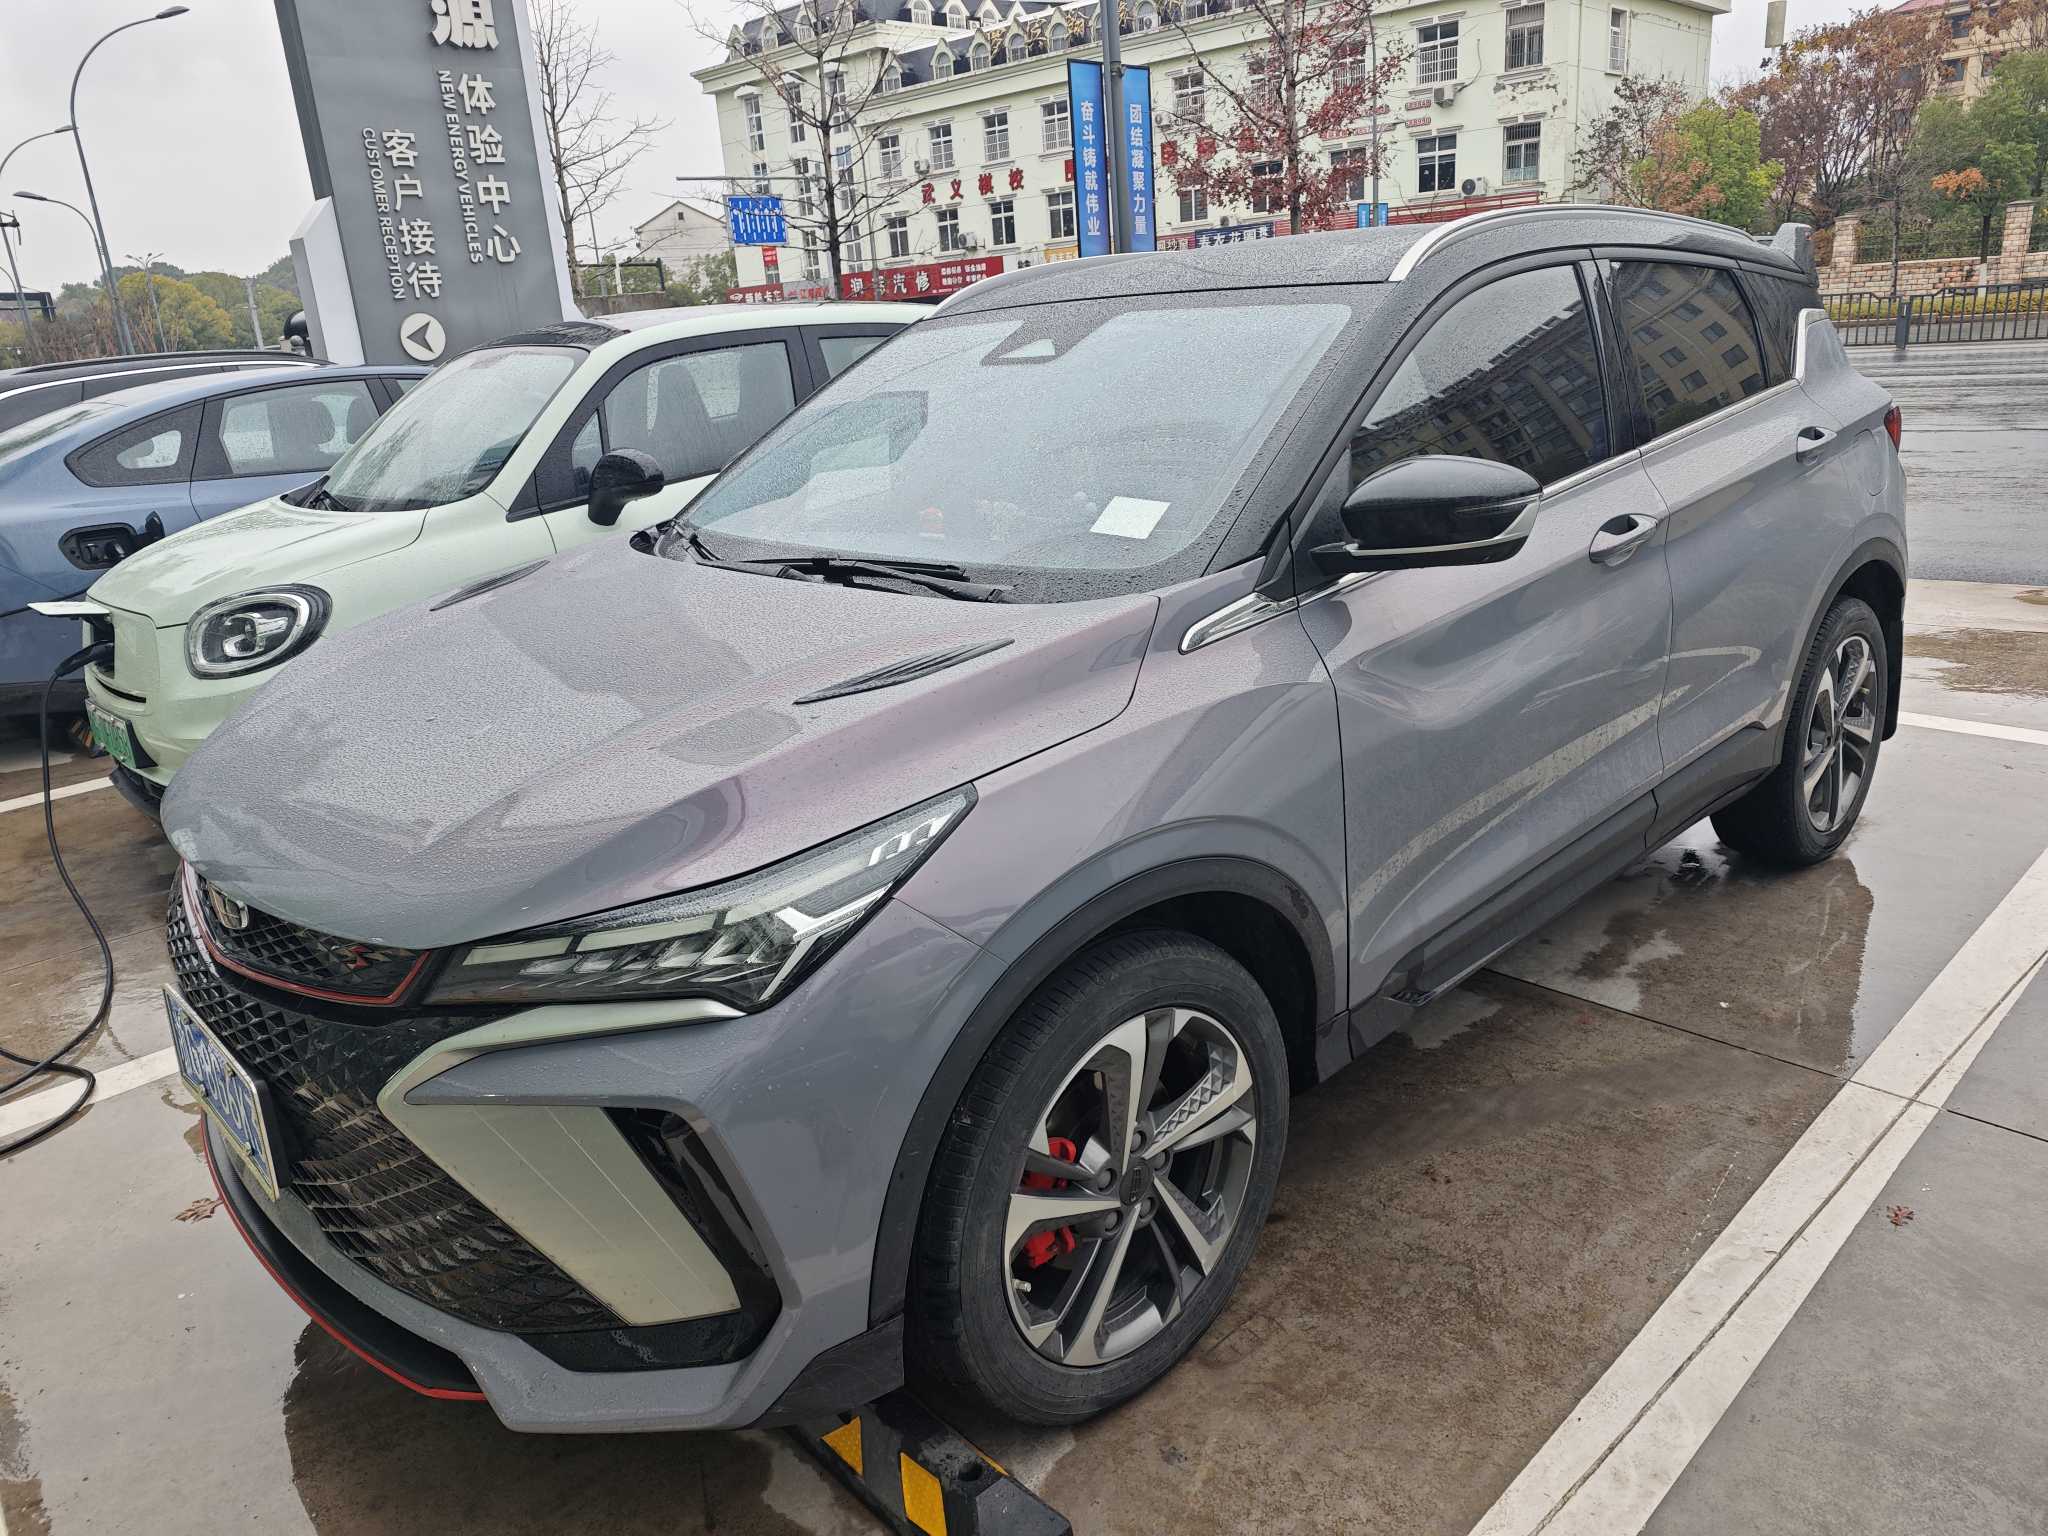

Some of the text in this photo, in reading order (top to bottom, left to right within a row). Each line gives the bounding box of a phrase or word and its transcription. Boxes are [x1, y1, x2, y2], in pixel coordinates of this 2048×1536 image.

[362, 127, 406, 299] CUSTOMER RECEPTION
[381, 128, 442, 298] 客户接待
[437, 70, 484, 264] NEW ENERGY VEHICLES
[457, 73, 521, 263] 体验中心
[1080, 100, 1101, 236] 奋斗铸就伟业
[1129, 103, 1148, 235] 团结凝聚力量
